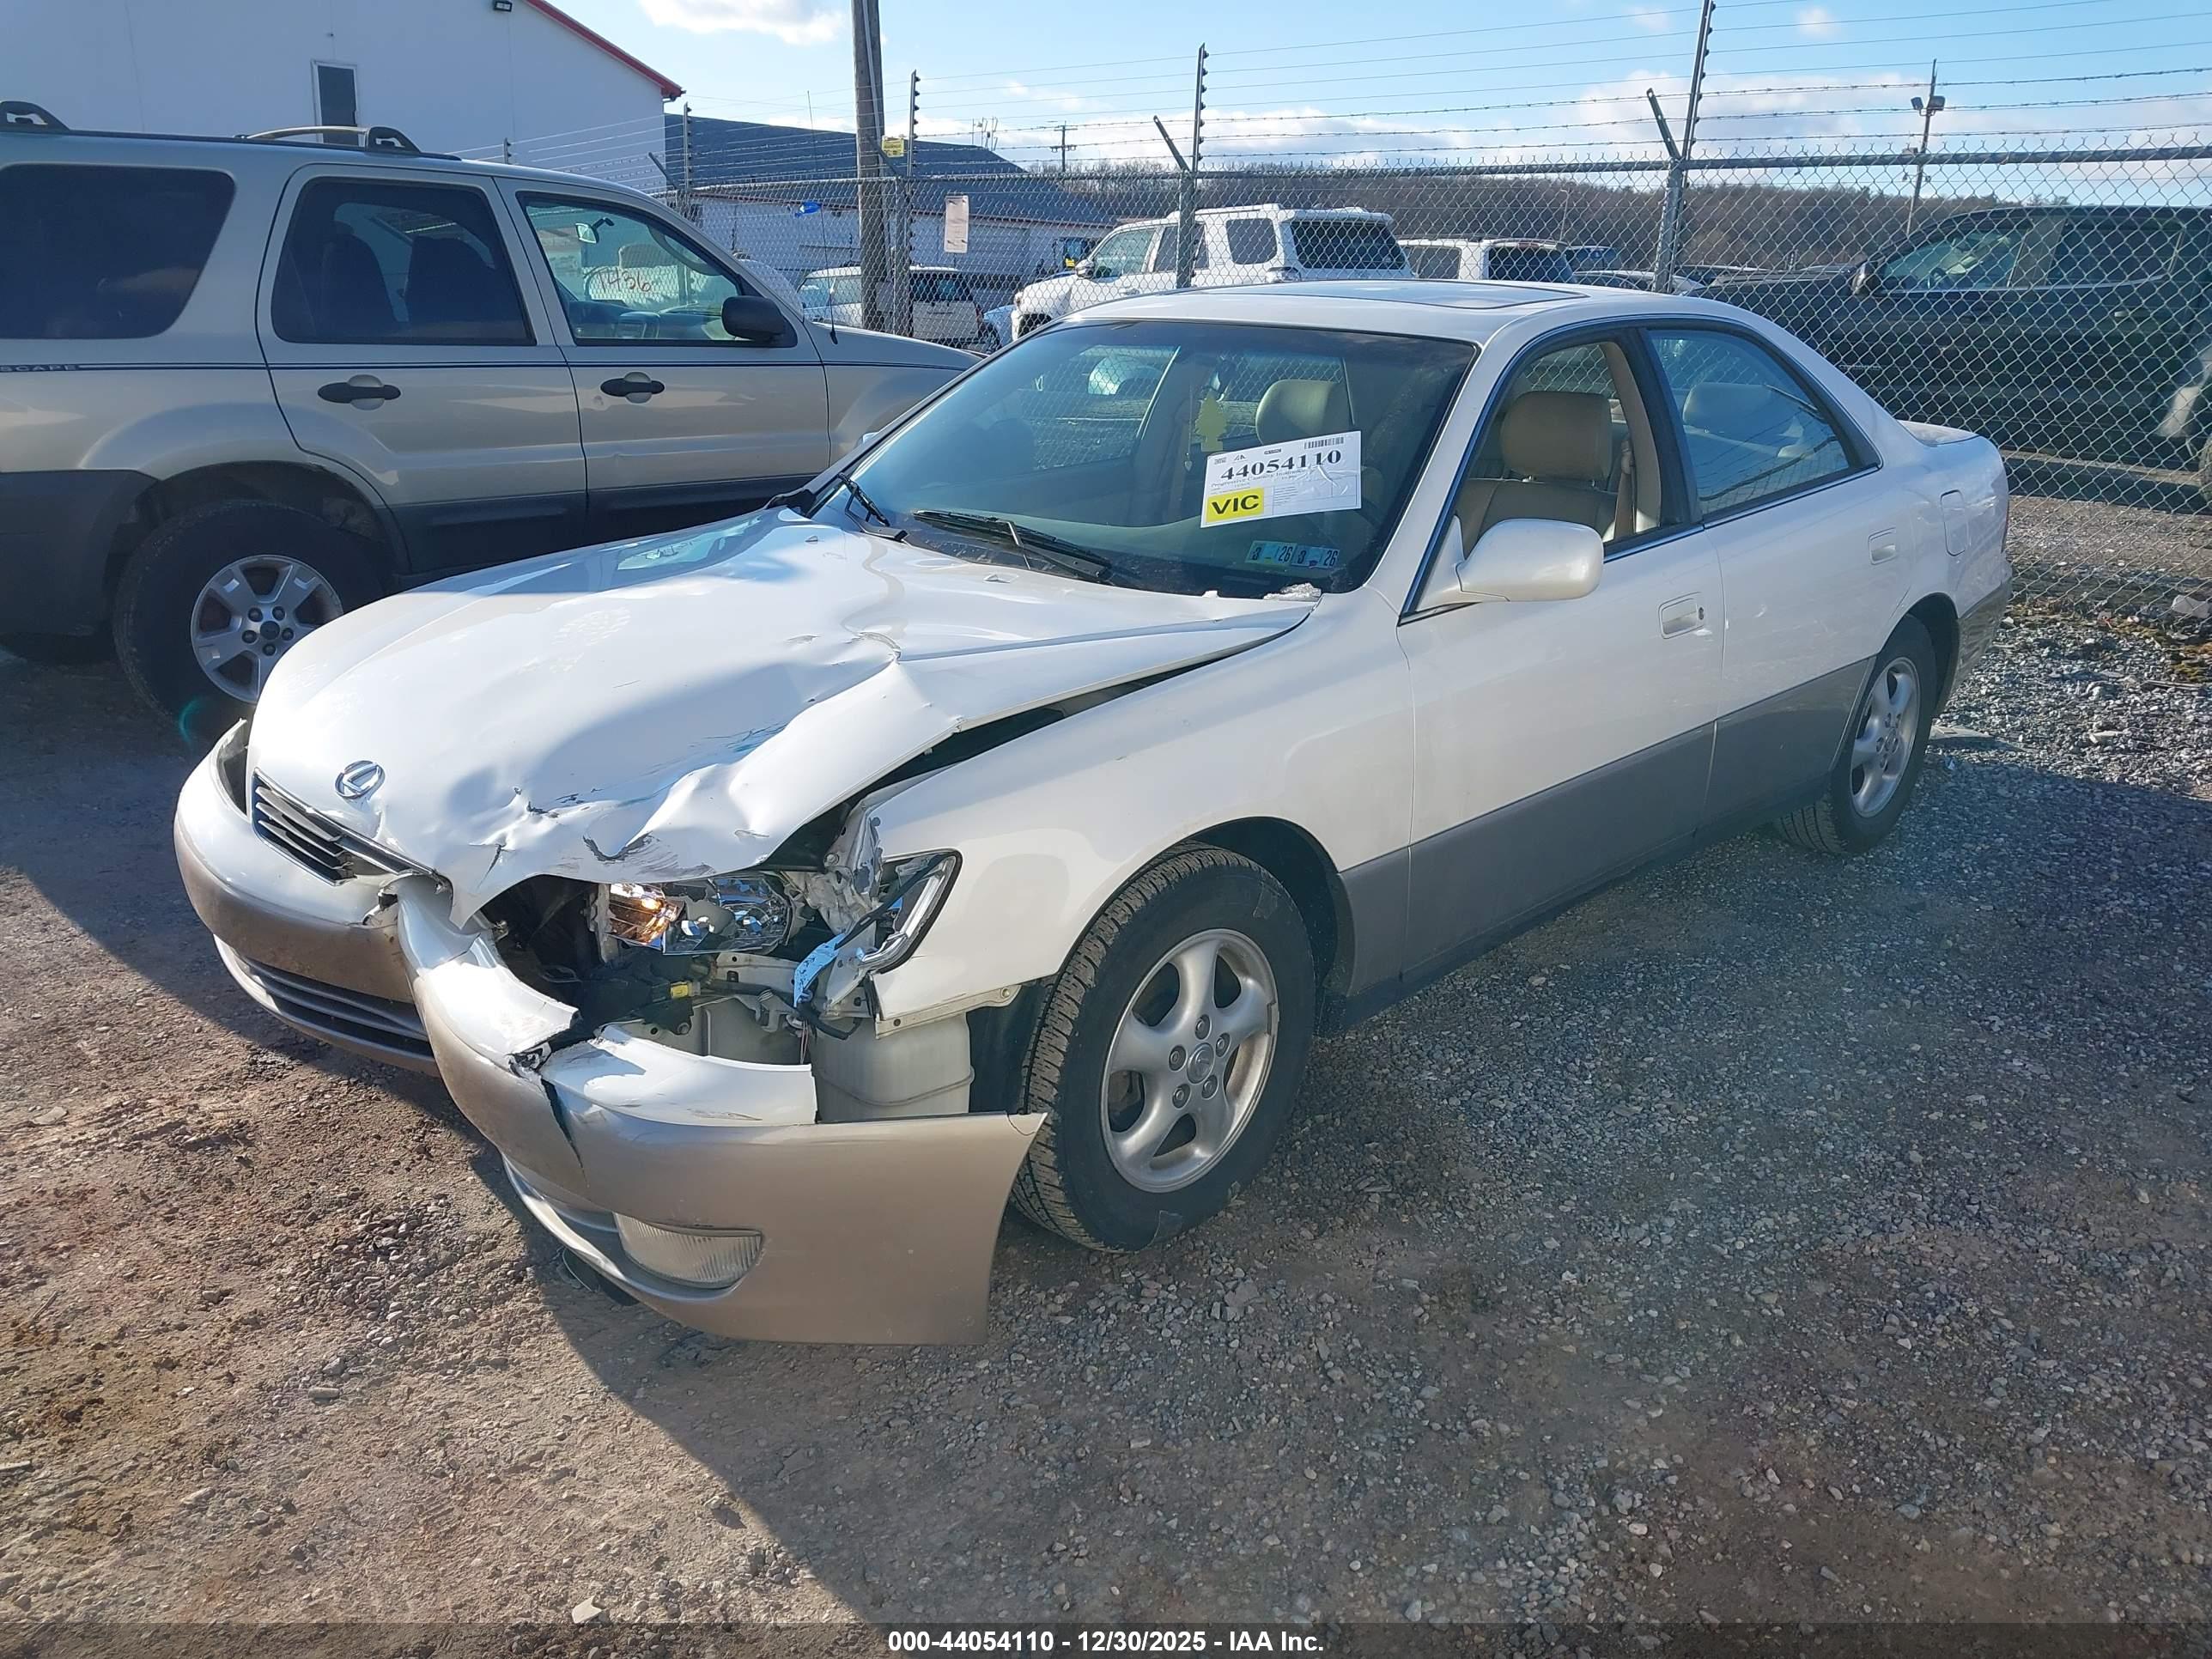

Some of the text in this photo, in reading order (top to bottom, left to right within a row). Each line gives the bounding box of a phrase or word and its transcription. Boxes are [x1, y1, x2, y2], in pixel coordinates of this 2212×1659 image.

[1220, 450, 1341, 480] 44054110
[1212, 495, 1260, 514] VIC
[1323, 550, 1339, 567] 26
